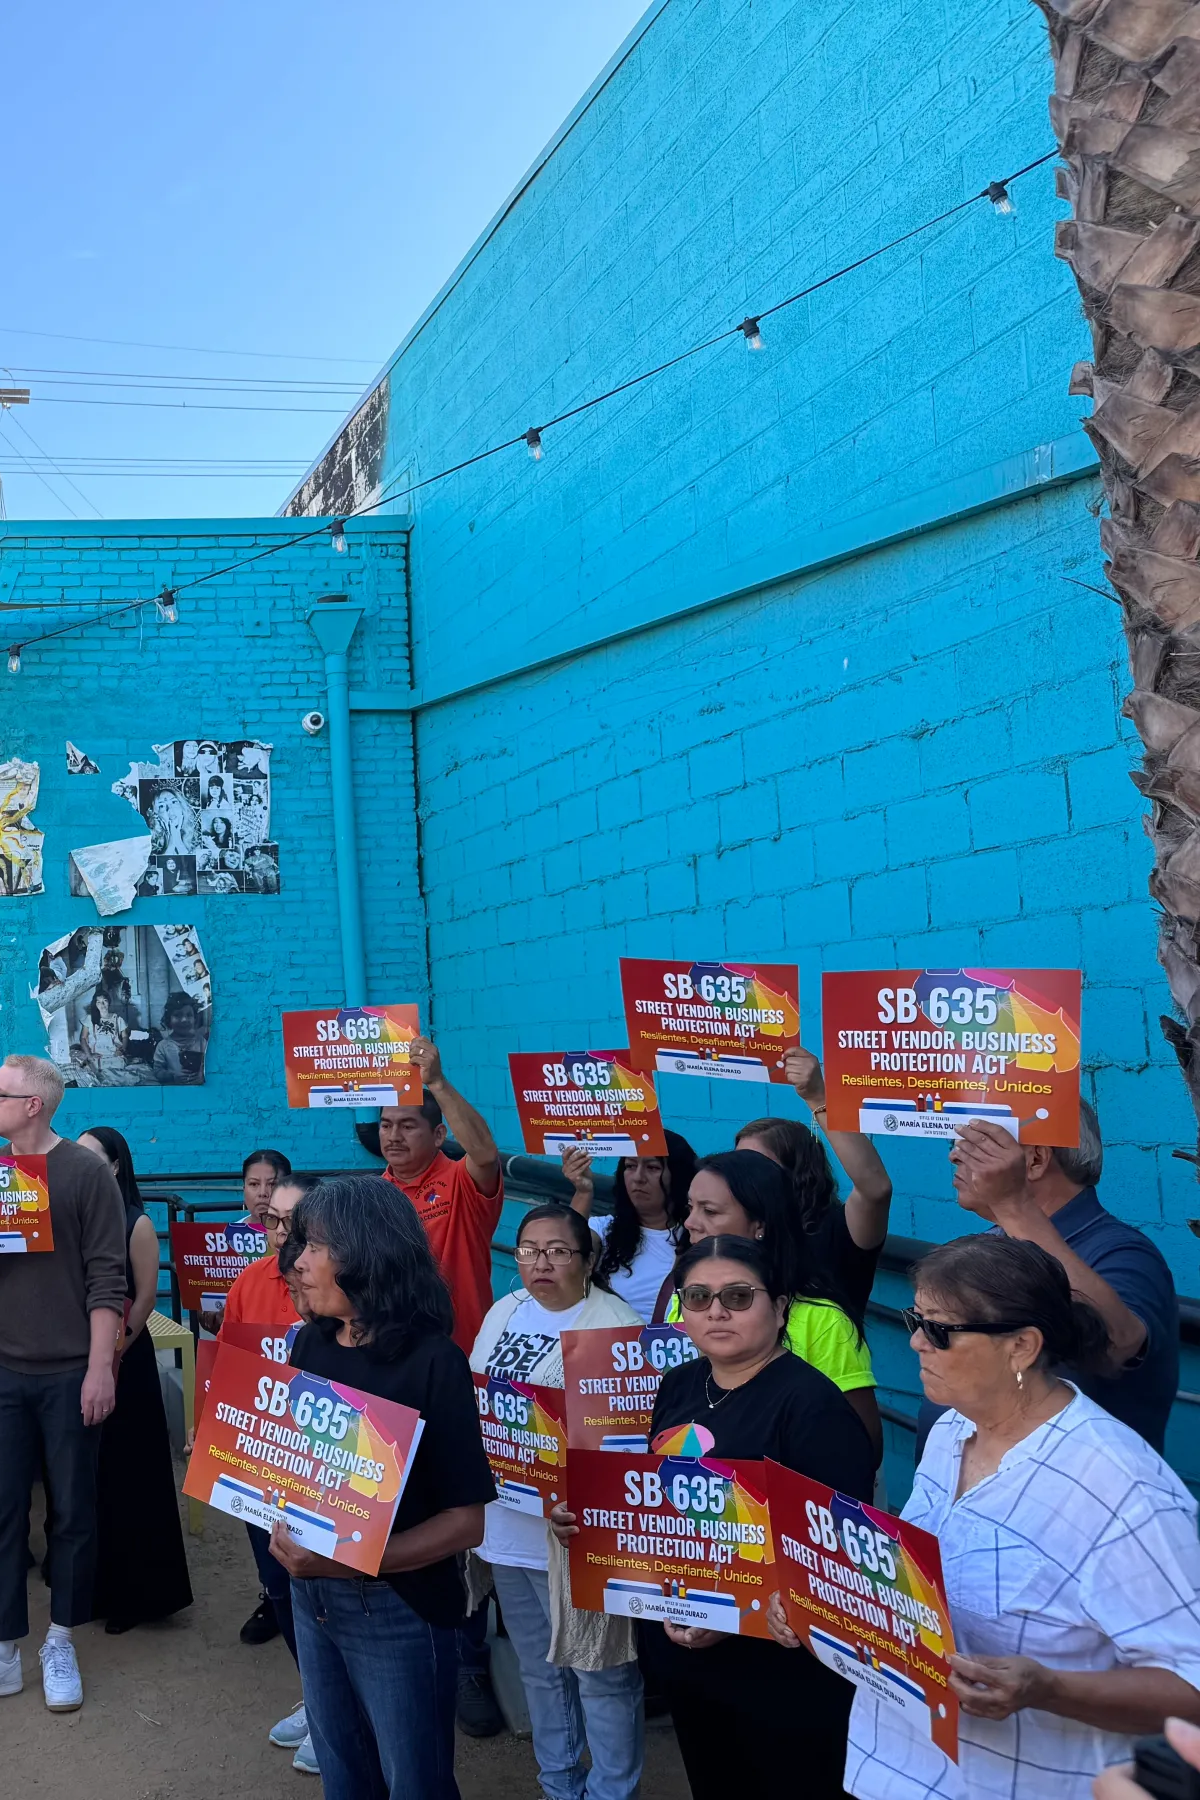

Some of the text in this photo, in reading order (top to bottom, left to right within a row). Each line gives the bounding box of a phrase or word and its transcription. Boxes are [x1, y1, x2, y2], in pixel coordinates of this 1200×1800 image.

[663, 973, 746, 1004] SB 635
[635, 1000, 784, 1025] STREET VENDOR BUSINESS
[877, 987, 998, 1026] SB 635
[316, 1017, 381, 1042] SB 635
[661, 1017, 756, 1038] PROTECTION ACT
[294, 1042, 410, 1058] STREET VENDOR BUSINESS
[640, 1031, 784, 1053] Resilientes, Desafiantes, Unidos
[838, 1030, 1057, 1054] STREET VENDOR BUSINESS
[298, 1072, 336, 1080] Resilientes,
[338, 1071, 383, 1079] Desafiantes,
[314, 1056, 390, 1070] PROTECTION ACT
[542, 1062, 611, 1087] SB 635
[871, 1053, 1008, 1075] PROTECTION ACT
[523, 1088, 645, 1103] STREET VENDOR BUSINESS
[842, 1075, 1052, 1095] Resilientes, Desafiantes, Unidos
[544, 1103, 623, 1116] PROTECTION ACT
[530, 1118, 648, 1128] Resilientes, Desafiantes, Unidos
[900, 1119, 920, 1129] MARÍA
[922, 1121, 943, 1130] ELENA
[1, 1204, 18, 1216] ACT
[205, 1233, 267, 1254] SB 635
[184, 1255, 213, 1266] STREET
[215, 1256, 249, 1267] VENDOR
[261, 1337, 288, 1365] SB
[611, 1337, 699, 1372] SB 635
[579, 1376, 663, 1395] STREET VENDO
[254, 1375, 352, 1441] SB 635
[494, 1391, 528, 1426] 635
[609, 1395, 656, 1413] PROTEC
[584, 1416, 638, 1426] Resilientes,
[215, 1401, 386, 1483] STREET VENDOR BUSINESS
[482, 1436, 536, 1465] TECTION ACT
[511, 1428, 559, 1453] BUSINESS
[235, 1432, 346, 1492] PROTECTION ACT
[208, 1445, 371, 1521] Resilientes, Desafiantes, Unidos
[529, 1467, 559, 1483] Unidos
[624, 1470, 726, 1515] SB 635
[243, 1505, 263, 1519] MARÍA
[583, 1508, 766, 1545] STREET VENDOR BUSINESS
[616, 1532, 734, 1565] PROTECTION ACT
[805, 1500, 898, 1581] SB 635
[586, 1553, 763, 1586] Resilientes, Desafiantes, Unidos
[781, 1533, 942, 1637] STREET VENDOR BUSINESS
[645, 1604, 666, 1614] MARÍA
[667, 1607, 684, 1617] ELENA
[685, 1609, 708, 1620] DURAZO
[808, 1573, 917, 1648] PROTECTION ACT
[789, 1588, 843, 1629] Resilientes,
[844, 1617, 910, 1666] Desafiantes,
[910, 1654, 948, 1688] Unidos
